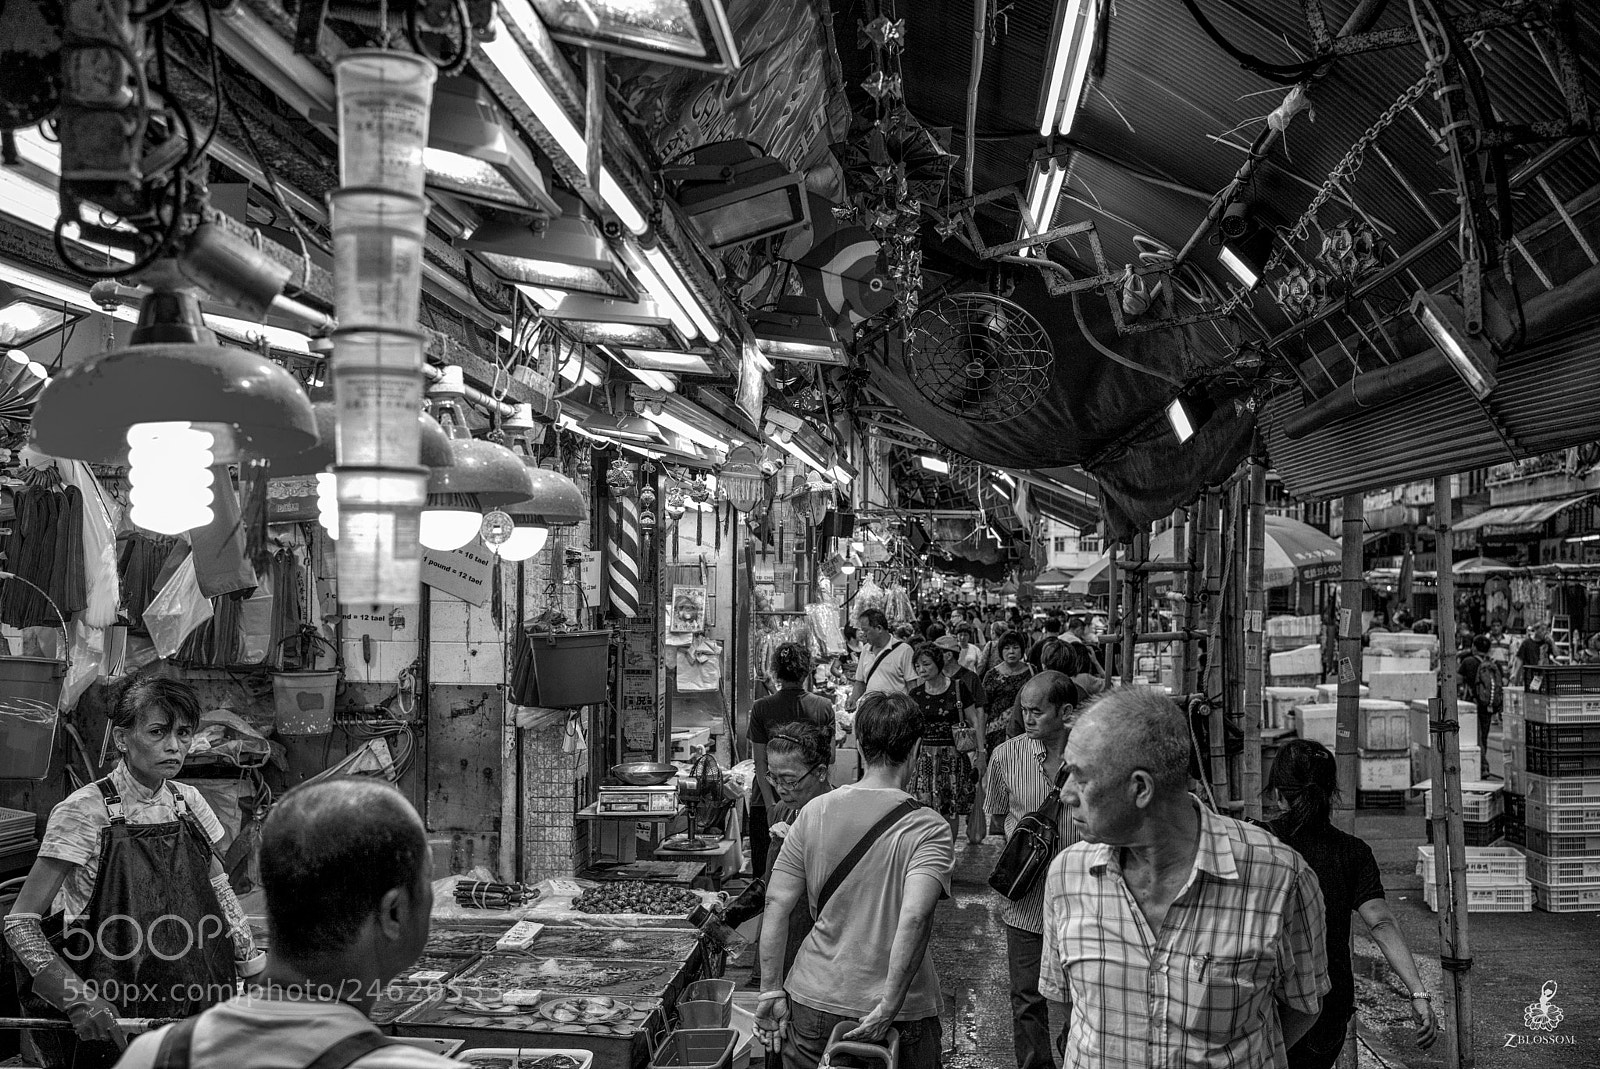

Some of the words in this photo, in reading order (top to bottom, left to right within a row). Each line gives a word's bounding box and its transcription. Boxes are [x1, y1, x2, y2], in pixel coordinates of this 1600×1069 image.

[464, 551, 474, 560] 16
[474, 556, 489, 566] tael
[428, 559, 452, 572] pound
[458, 571, 468, 580] 12
[468, 575, 483, 586] tael
